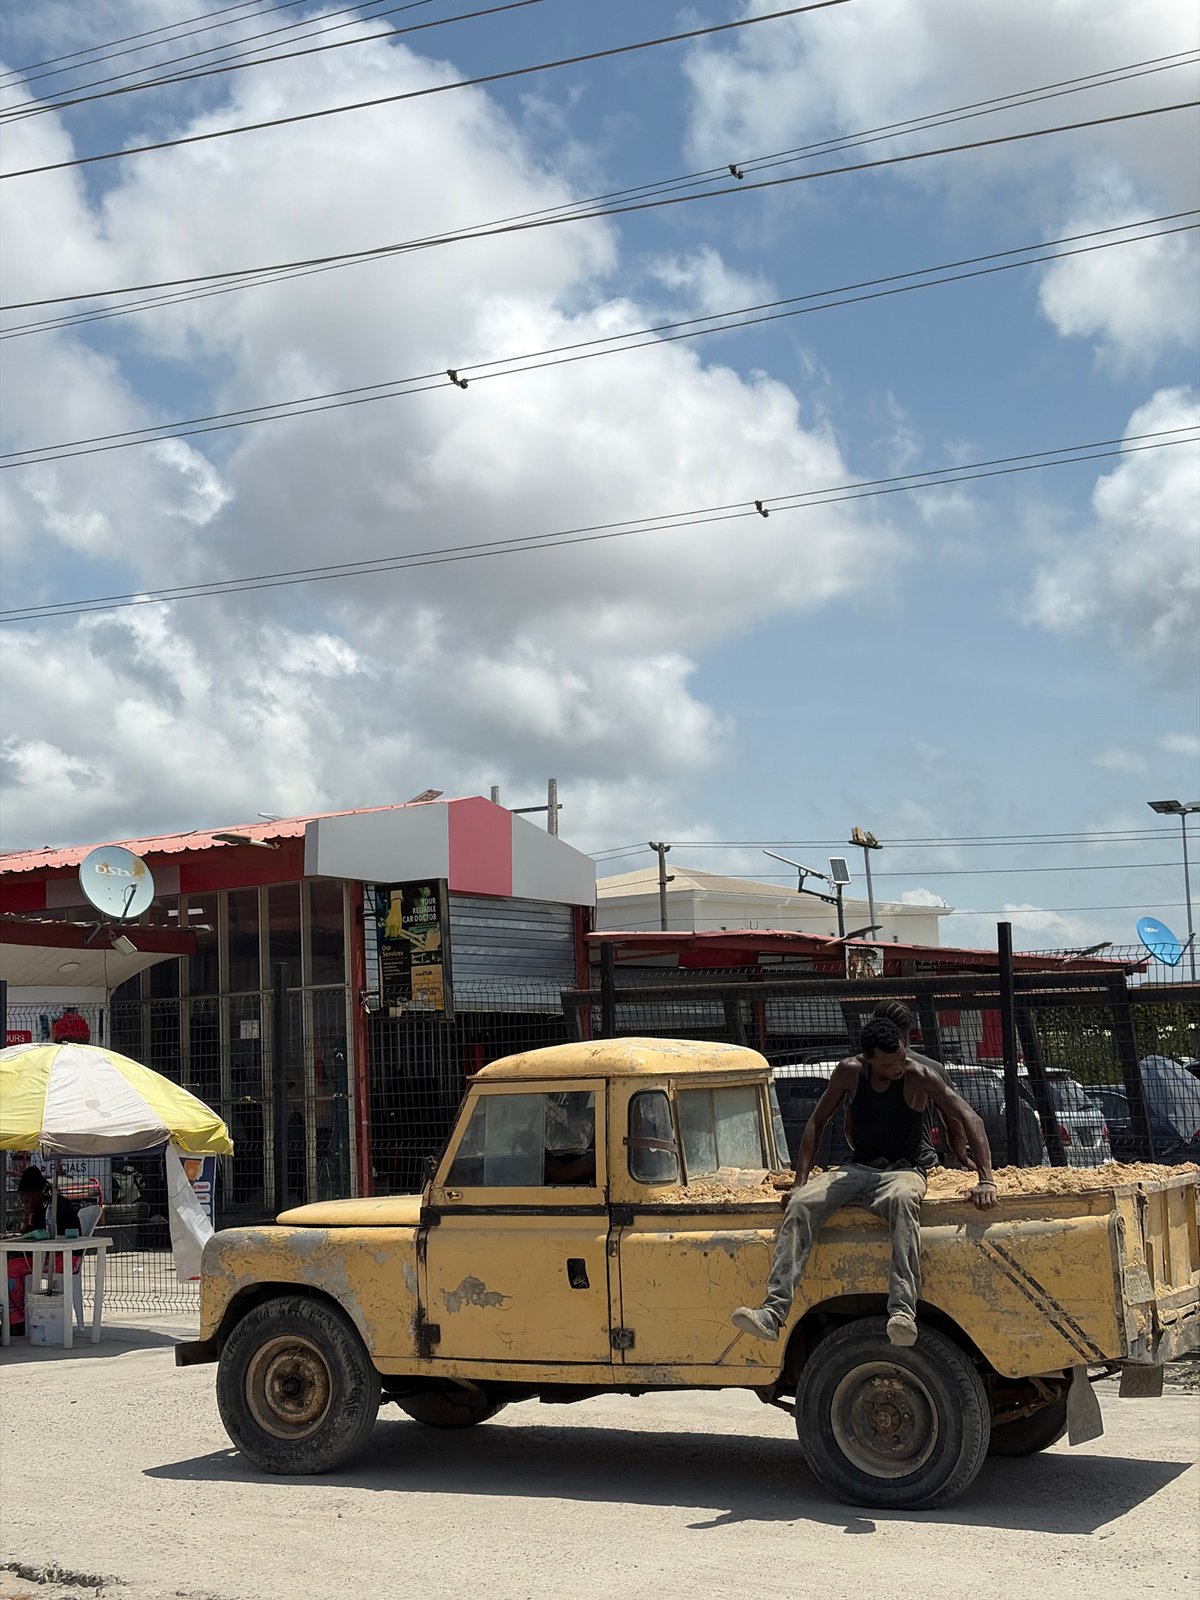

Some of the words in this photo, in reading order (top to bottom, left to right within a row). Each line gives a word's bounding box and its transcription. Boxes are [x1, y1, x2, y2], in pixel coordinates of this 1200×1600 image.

[421, 897, 437, 905] YOUR
[412, 905, 437, 914] RELIABLE
[402, 915, 414, 923] CAR
[414, 913, 437, 922] DOCTOR
[50, 1162, 87, 1173] FCIALS
